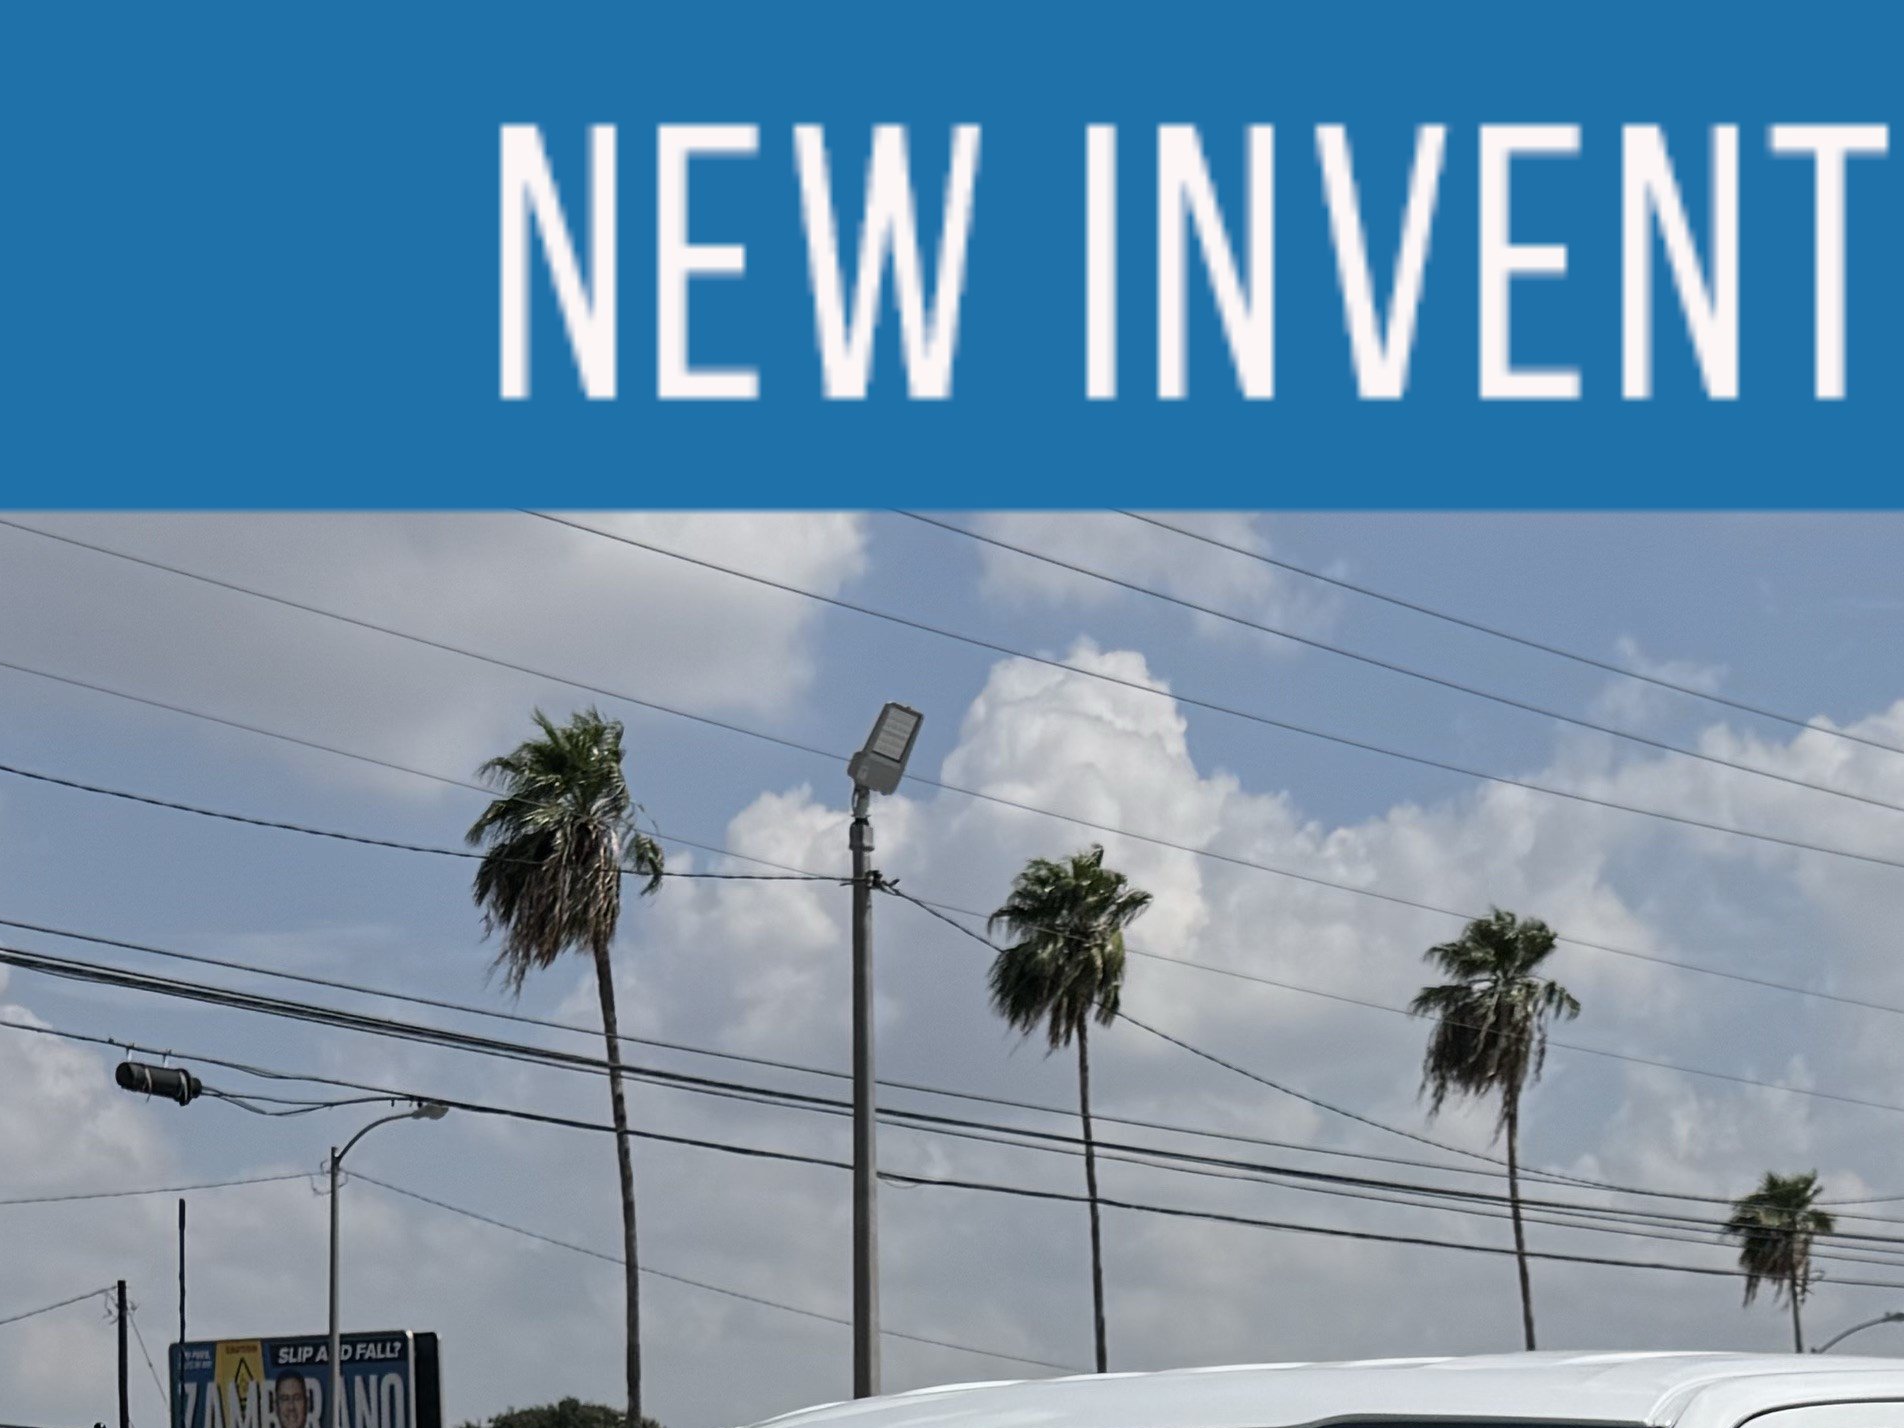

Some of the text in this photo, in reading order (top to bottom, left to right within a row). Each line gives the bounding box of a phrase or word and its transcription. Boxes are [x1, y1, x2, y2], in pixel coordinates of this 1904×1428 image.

[277, 1346, 314, 1364] SLIP
[315, 1344, 353, 1362] AD
[355, 1341, 402, 1360] FALL?
